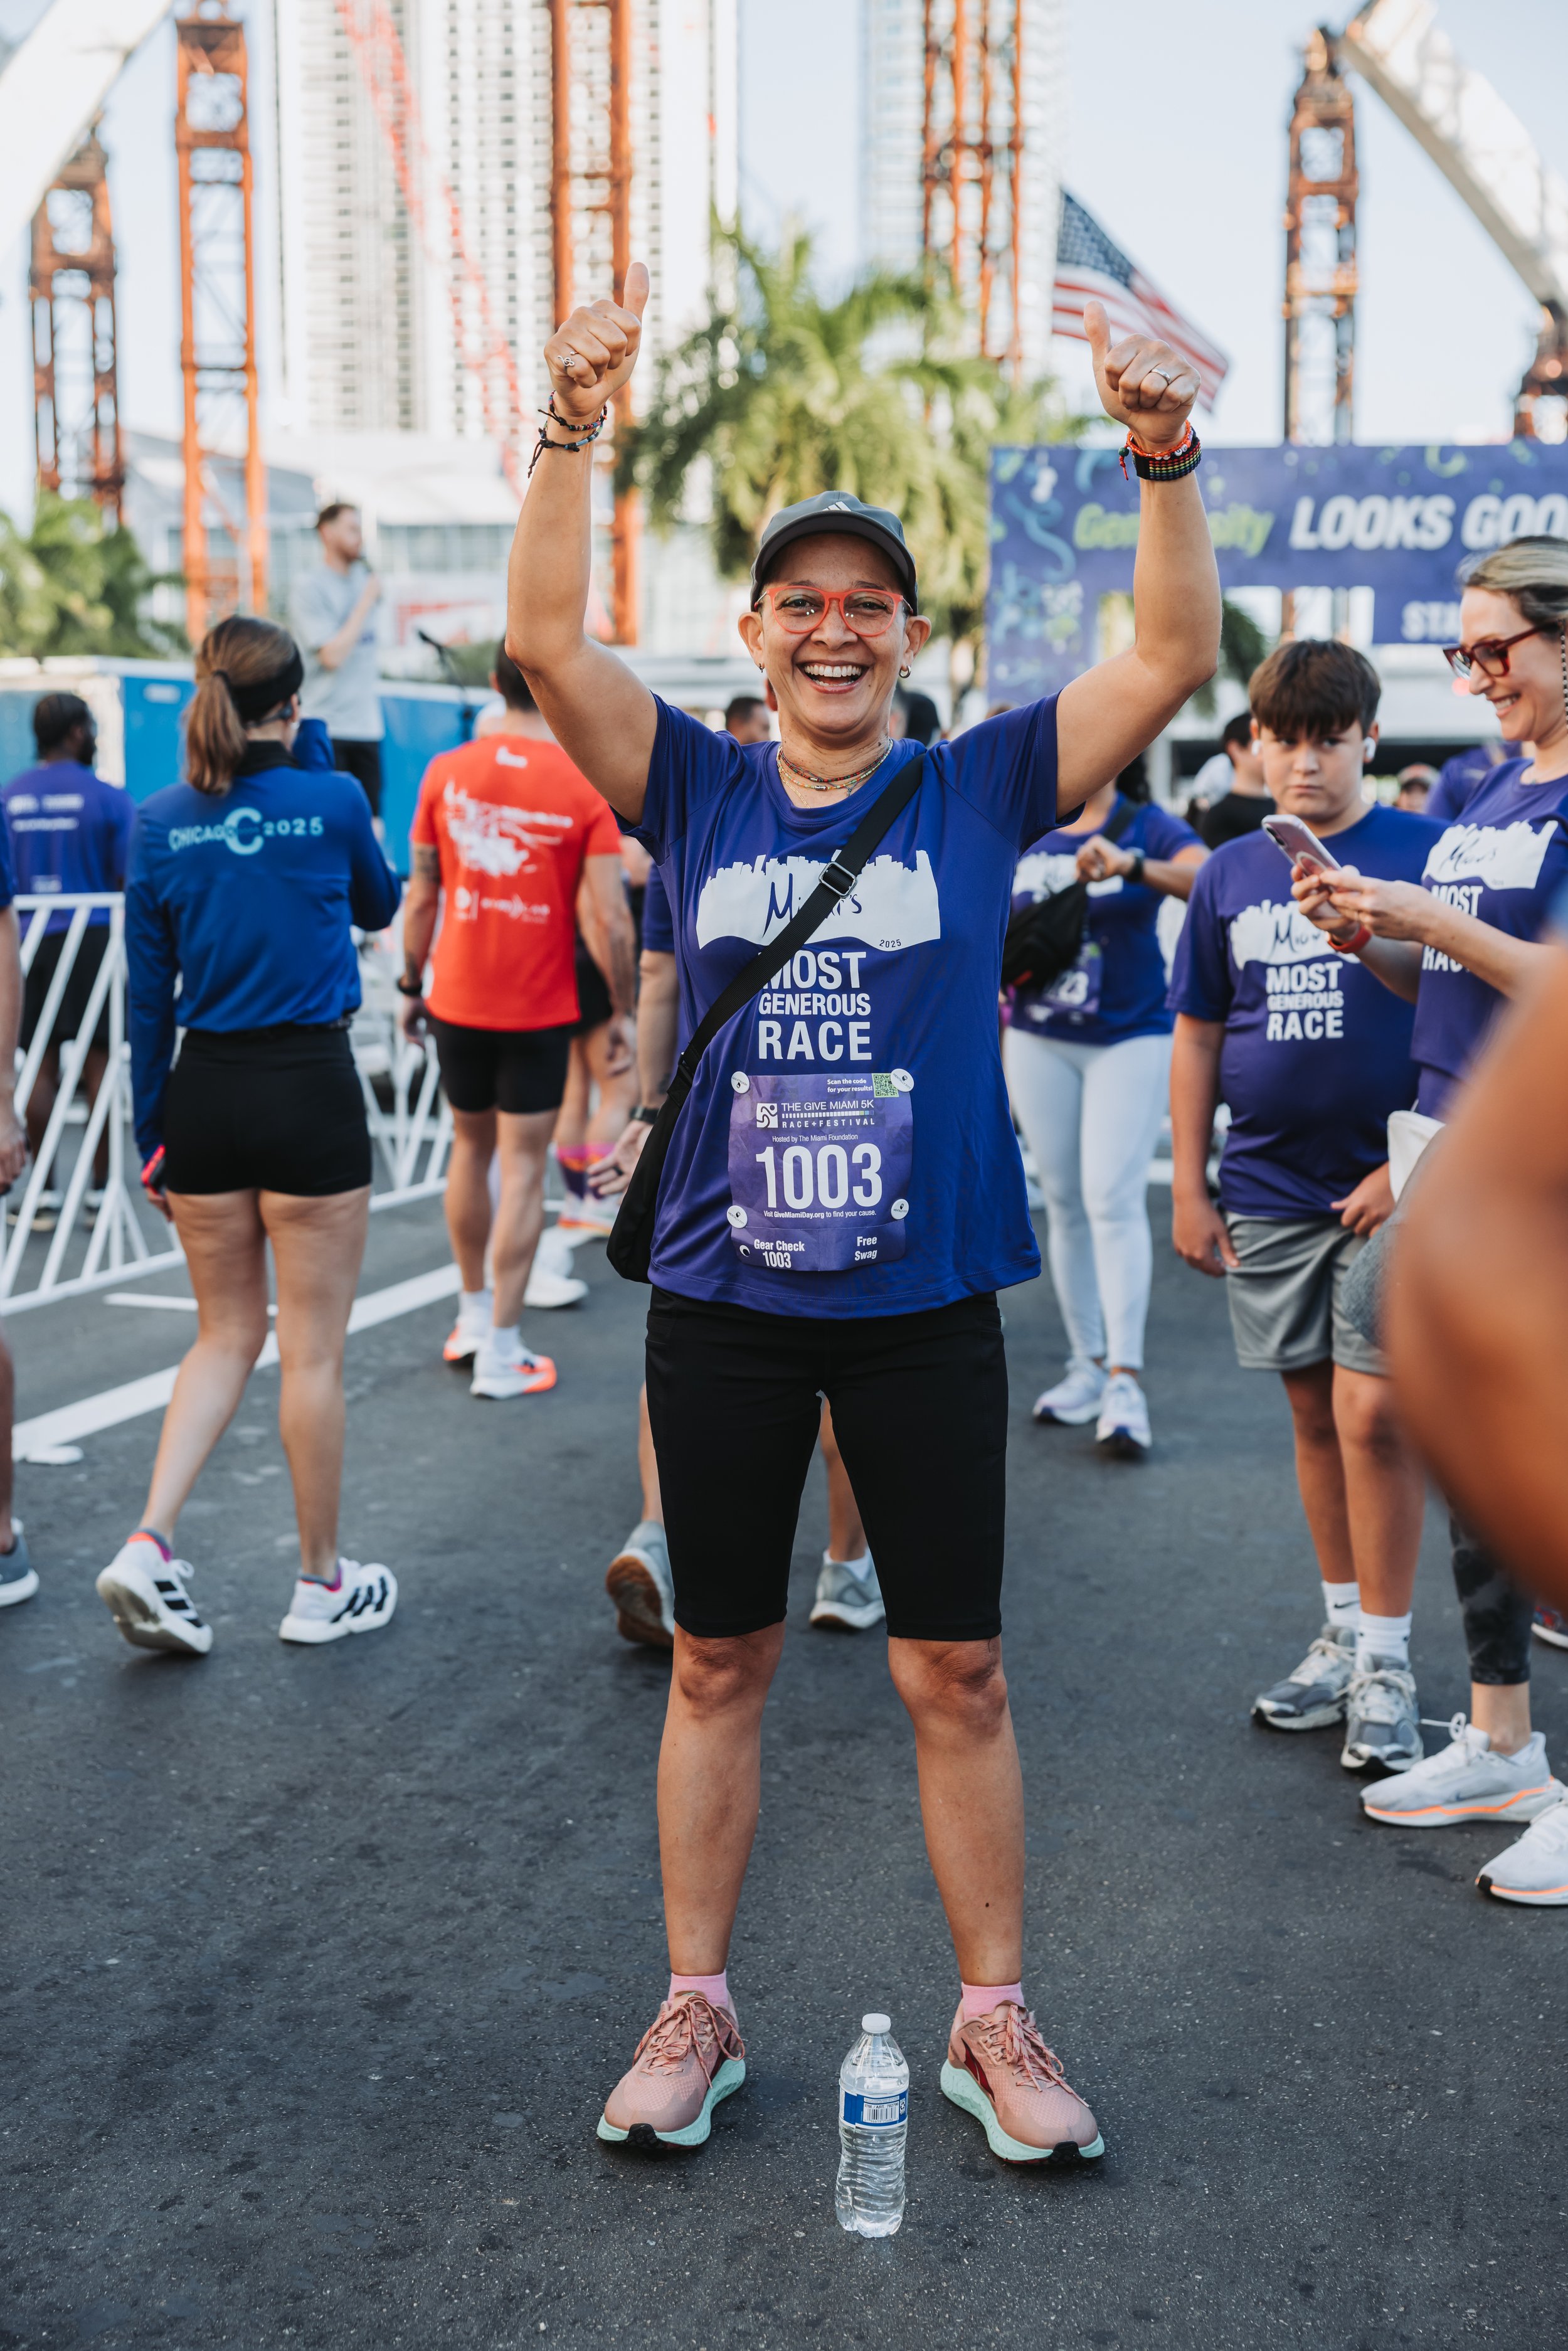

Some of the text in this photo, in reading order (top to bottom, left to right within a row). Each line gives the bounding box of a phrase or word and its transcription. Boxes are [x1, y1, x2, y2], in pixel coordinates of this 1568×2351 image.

[1289, 495, 1456, 551] LOOKS
[263, 816, 324, 837] 2025
[879, 939, 902, 949] 2025
[1266, 961, 1343, 994] MOST
[758, 992, 871, 1016] GENEROUS
[1266, 990, 1345, 1012] GENEROUS
[1266, 1009, 1344, 1042] RACE
[758, 1020, 872, 1061] RACE
[781, 1100, 874, 1112] THE GIVE MIAMI 5K
[791, 1135, 798, 1144] by
[755, 1142, 882, 1209] 1003
[773, 1211, 825, 1219] GiveMiamiDay.org
[845, 1211, 857, 1219] your
[754, 1239, 805, 1252] Gear Check
[857, 1236, 877, 1246] Free
[763, 1251, 792, 1269] 1003
[854, 1249, 877, 1261] Swag
